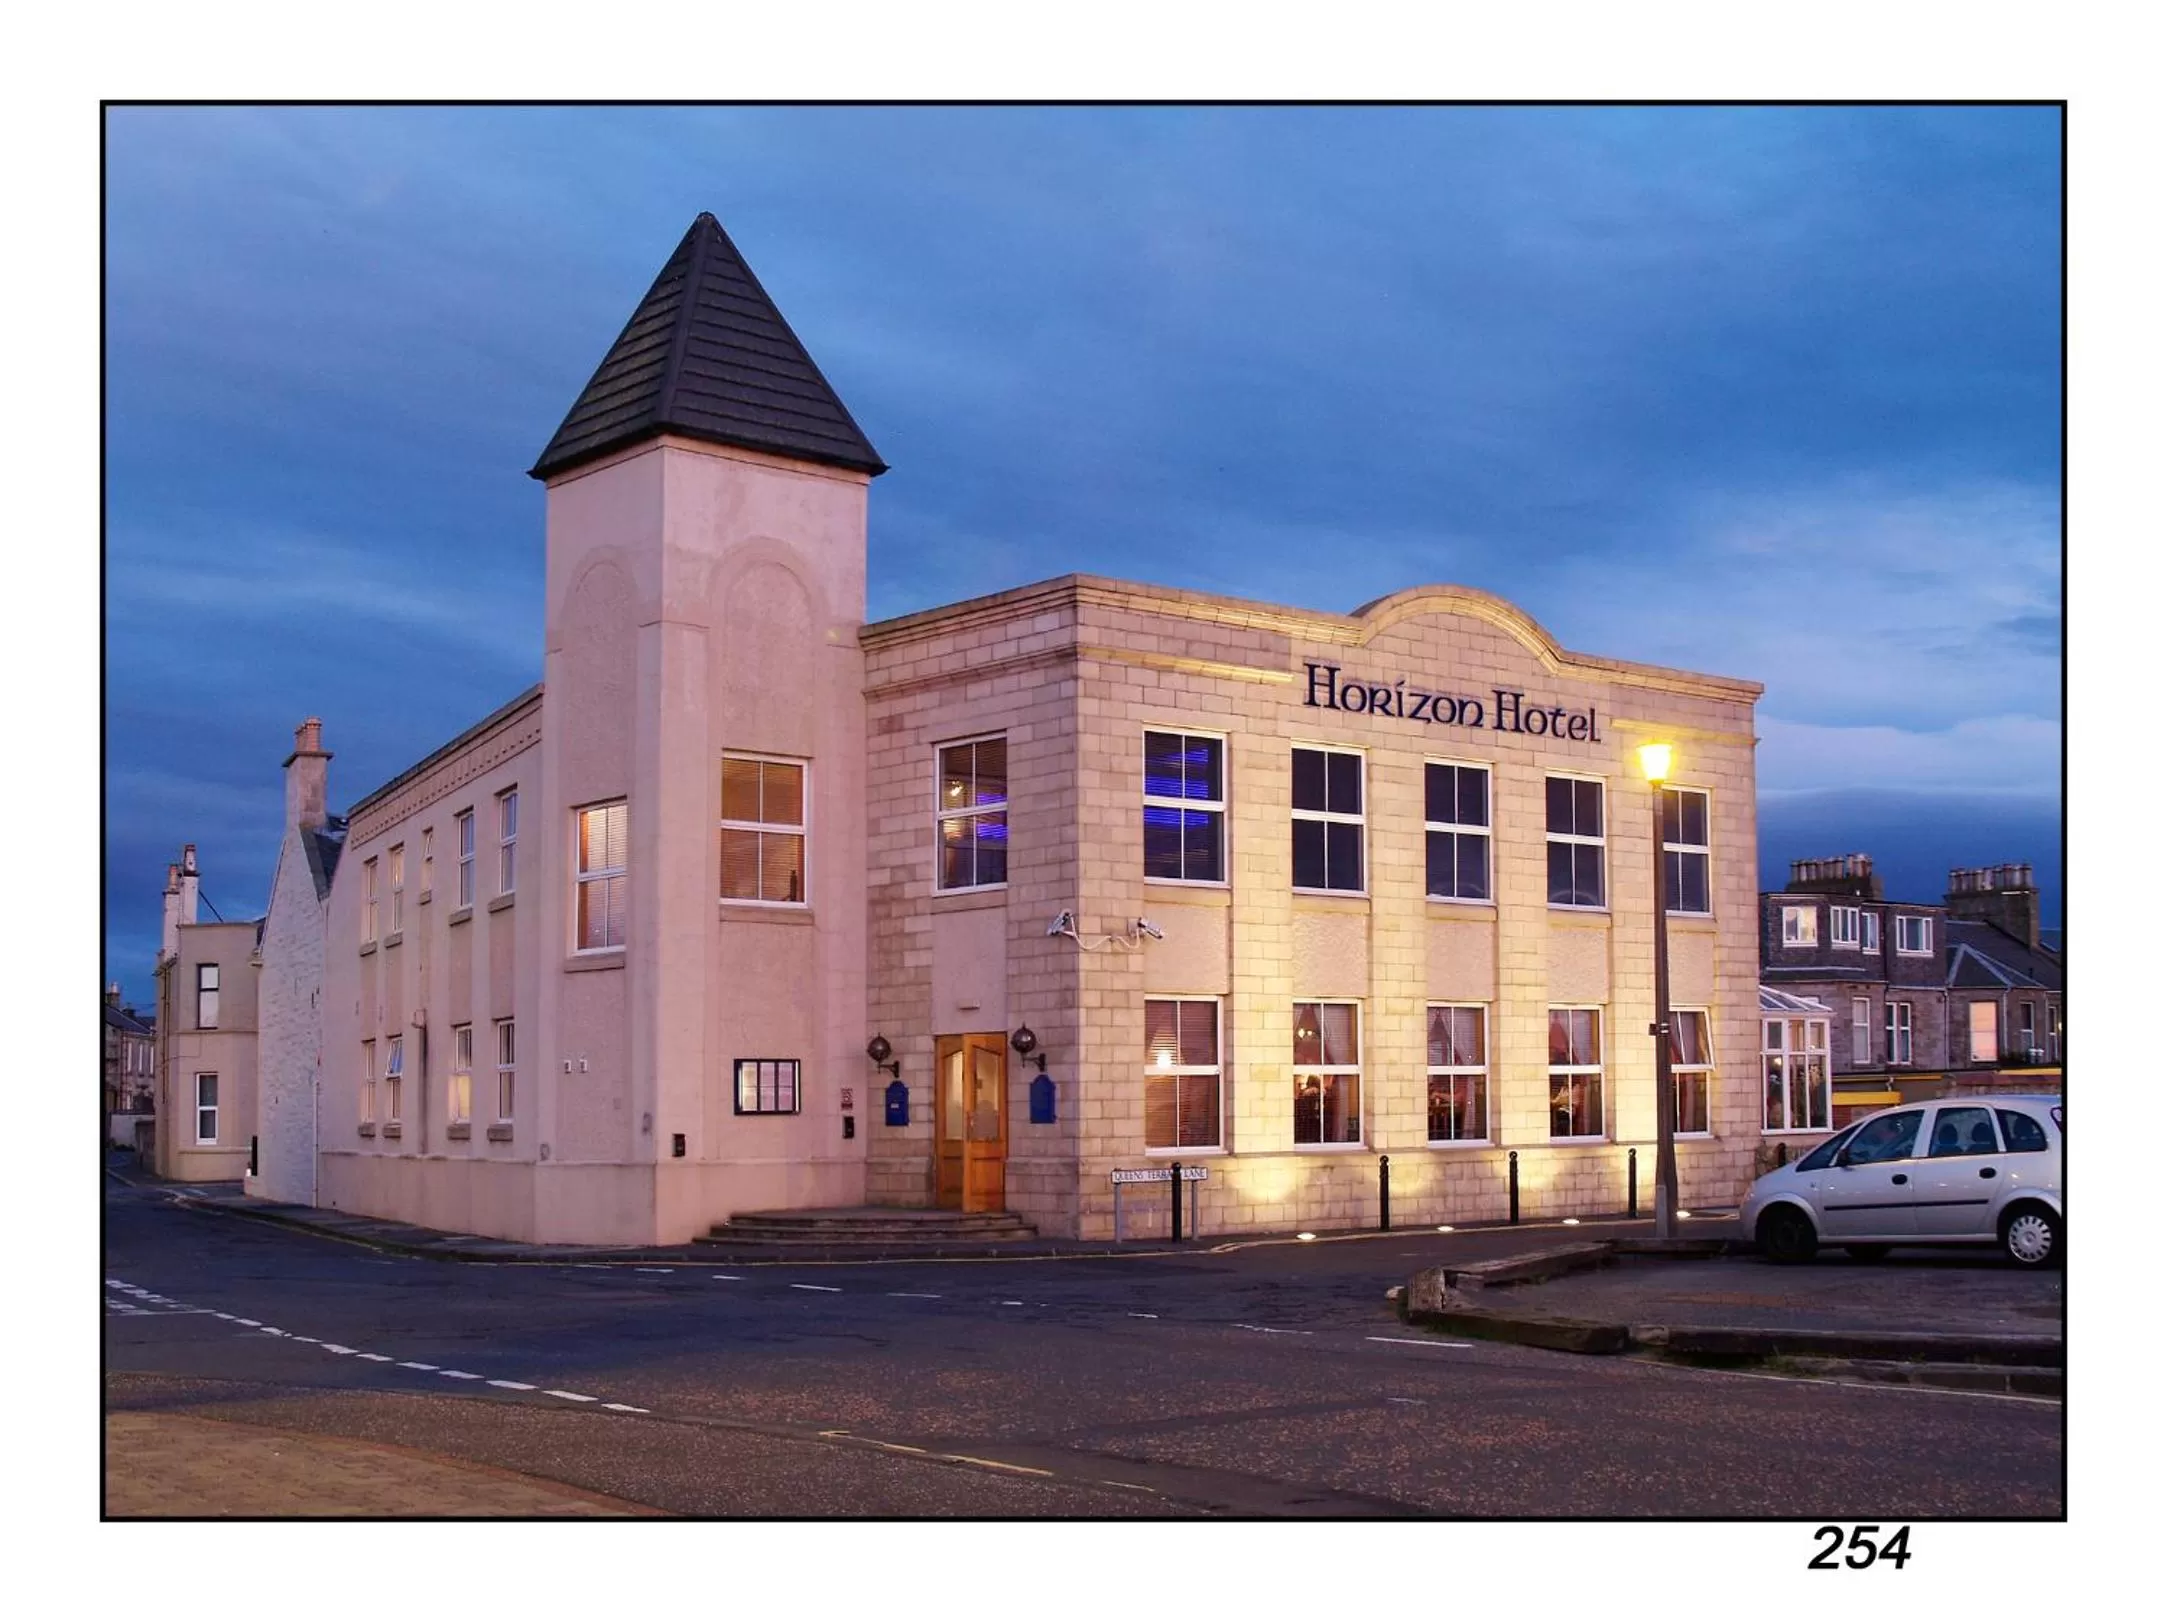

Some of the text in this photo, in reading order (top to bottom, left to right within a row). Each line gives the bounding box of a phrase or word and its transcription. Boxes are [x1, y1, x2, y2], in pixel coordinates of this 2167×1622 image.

[1303, 663, 1601, 743] Horizon Hotel
[1148, 1170, 1173, 1179] TERRA
[1184, 1168, 1205, 1177] LANE
